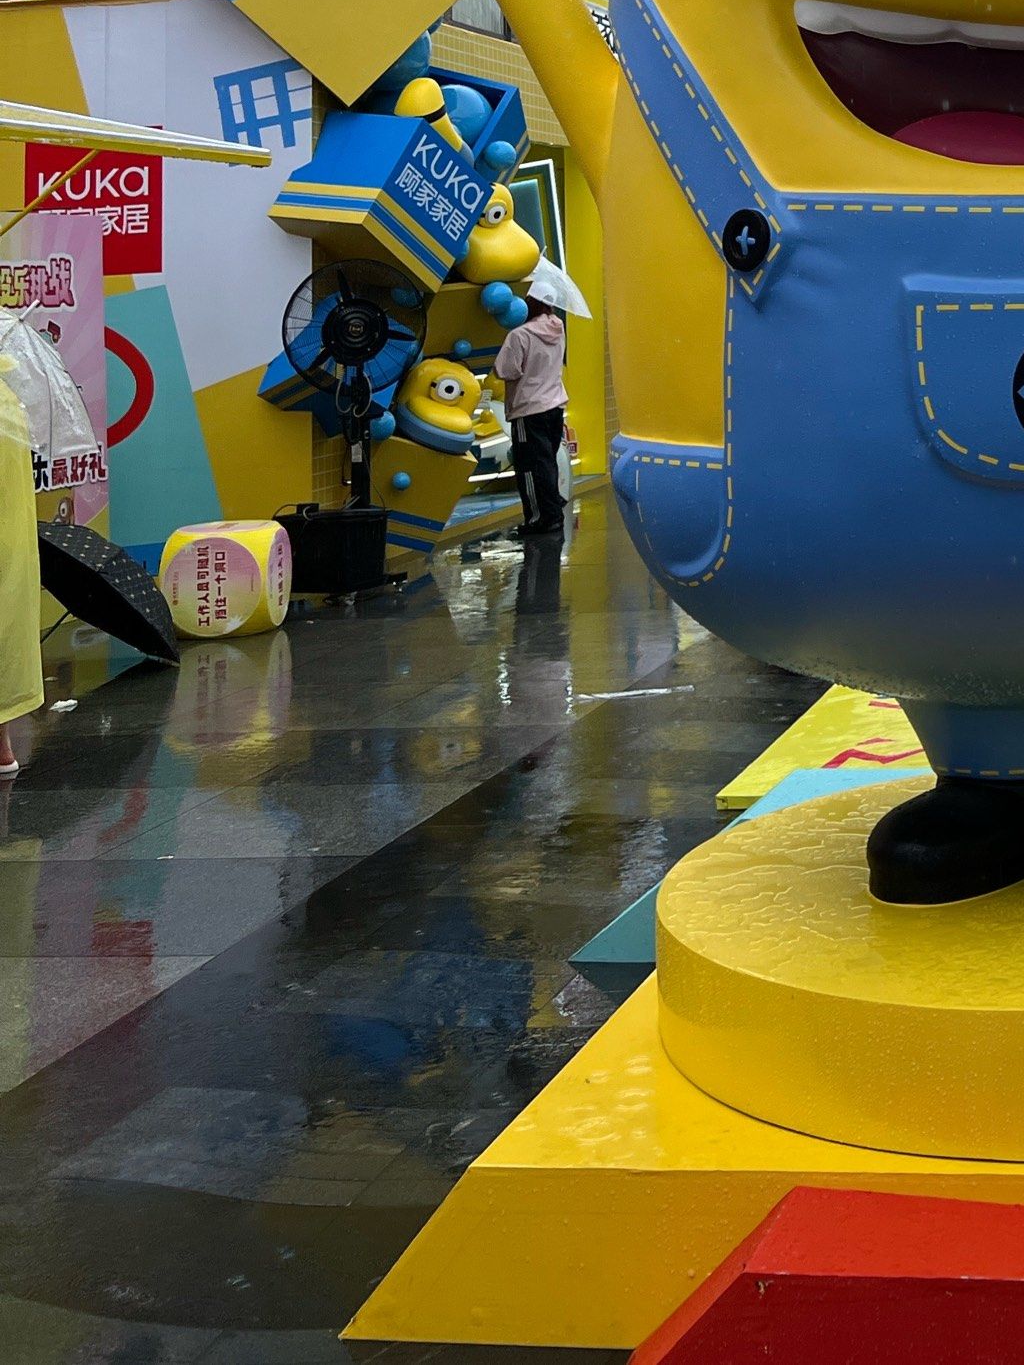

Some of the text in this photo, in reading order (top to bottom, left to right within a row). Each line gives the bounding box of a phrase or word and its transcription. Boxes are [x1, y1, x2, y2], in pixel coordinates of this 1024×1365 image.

[38, 203, 149, 235] 家居
[394, 162, 469, 242] 顾家家居
[197, 546, 210, 626] 工作人员可随机
